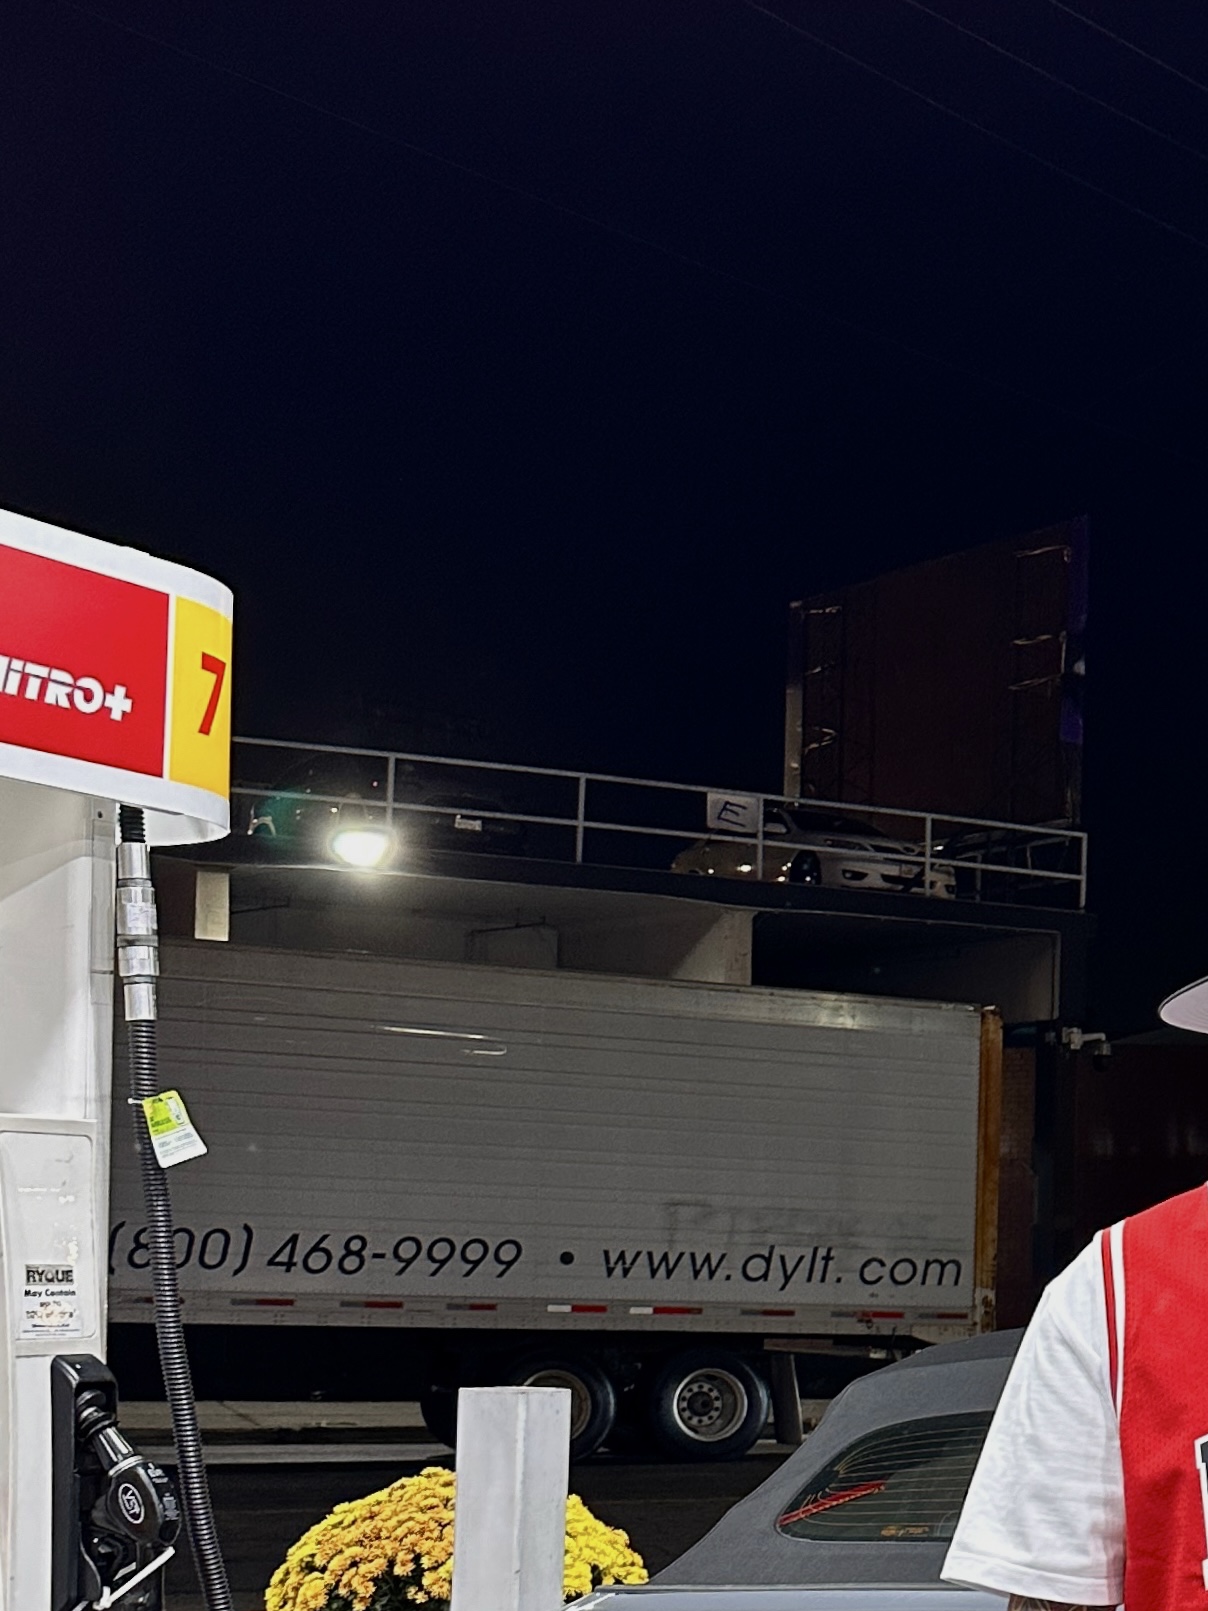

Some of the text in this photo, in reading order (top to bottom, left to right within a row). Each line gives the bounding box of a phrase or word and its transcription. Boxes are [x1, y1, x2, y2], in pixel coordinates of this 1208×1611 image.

[198, 652, 227, 736] 7
[717, 801, 748, 828] E
[109, 1220, 253, 1277] (800)
[266, 1233, 523, 1278] 468-9999
